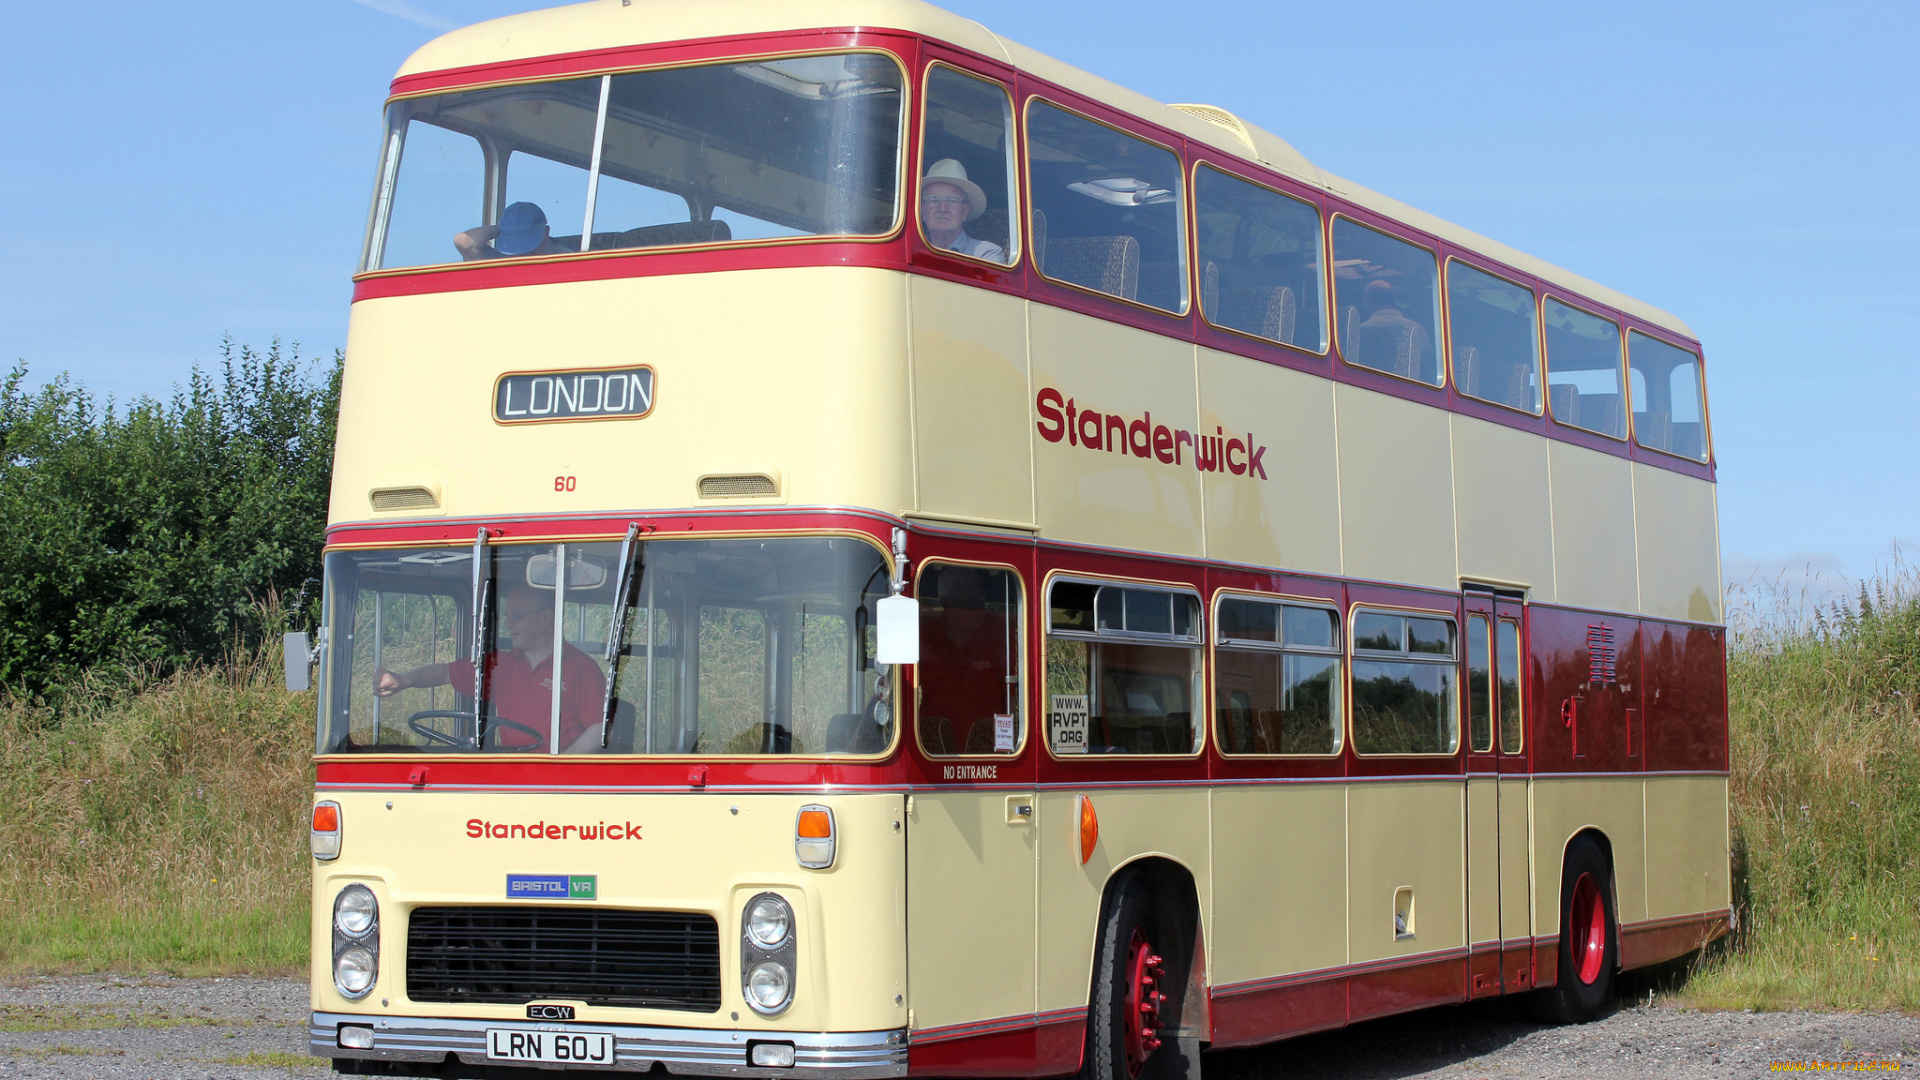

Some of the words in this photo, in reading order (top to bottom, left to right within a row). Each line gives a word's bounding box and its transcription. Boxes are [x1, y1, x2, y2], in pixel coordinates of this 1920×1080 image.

[505, 374, 653, 415] LONDON
[1036, 387, 1268, 480] Standerwick
[555, 476, 576, 492] 60
[1056, 698, 1084, 709] WWW.
[1053, 712, 1087, 727] RVPT
[1058, 731, 1083, 743] .ORG
[943, 766, 955, 779] NO
[957, 766, 997, 779] ENTRANCE
[466, 819, 643, 840] Standerwick
[512, 881, 566, 892] BRISTOL
[573, 882, 591, 892] VR
[530, 1006, 571, 1018] ECW
[494, 1032, 541, 1058] LRN
[555, 1035, 605, 1060] 60J
